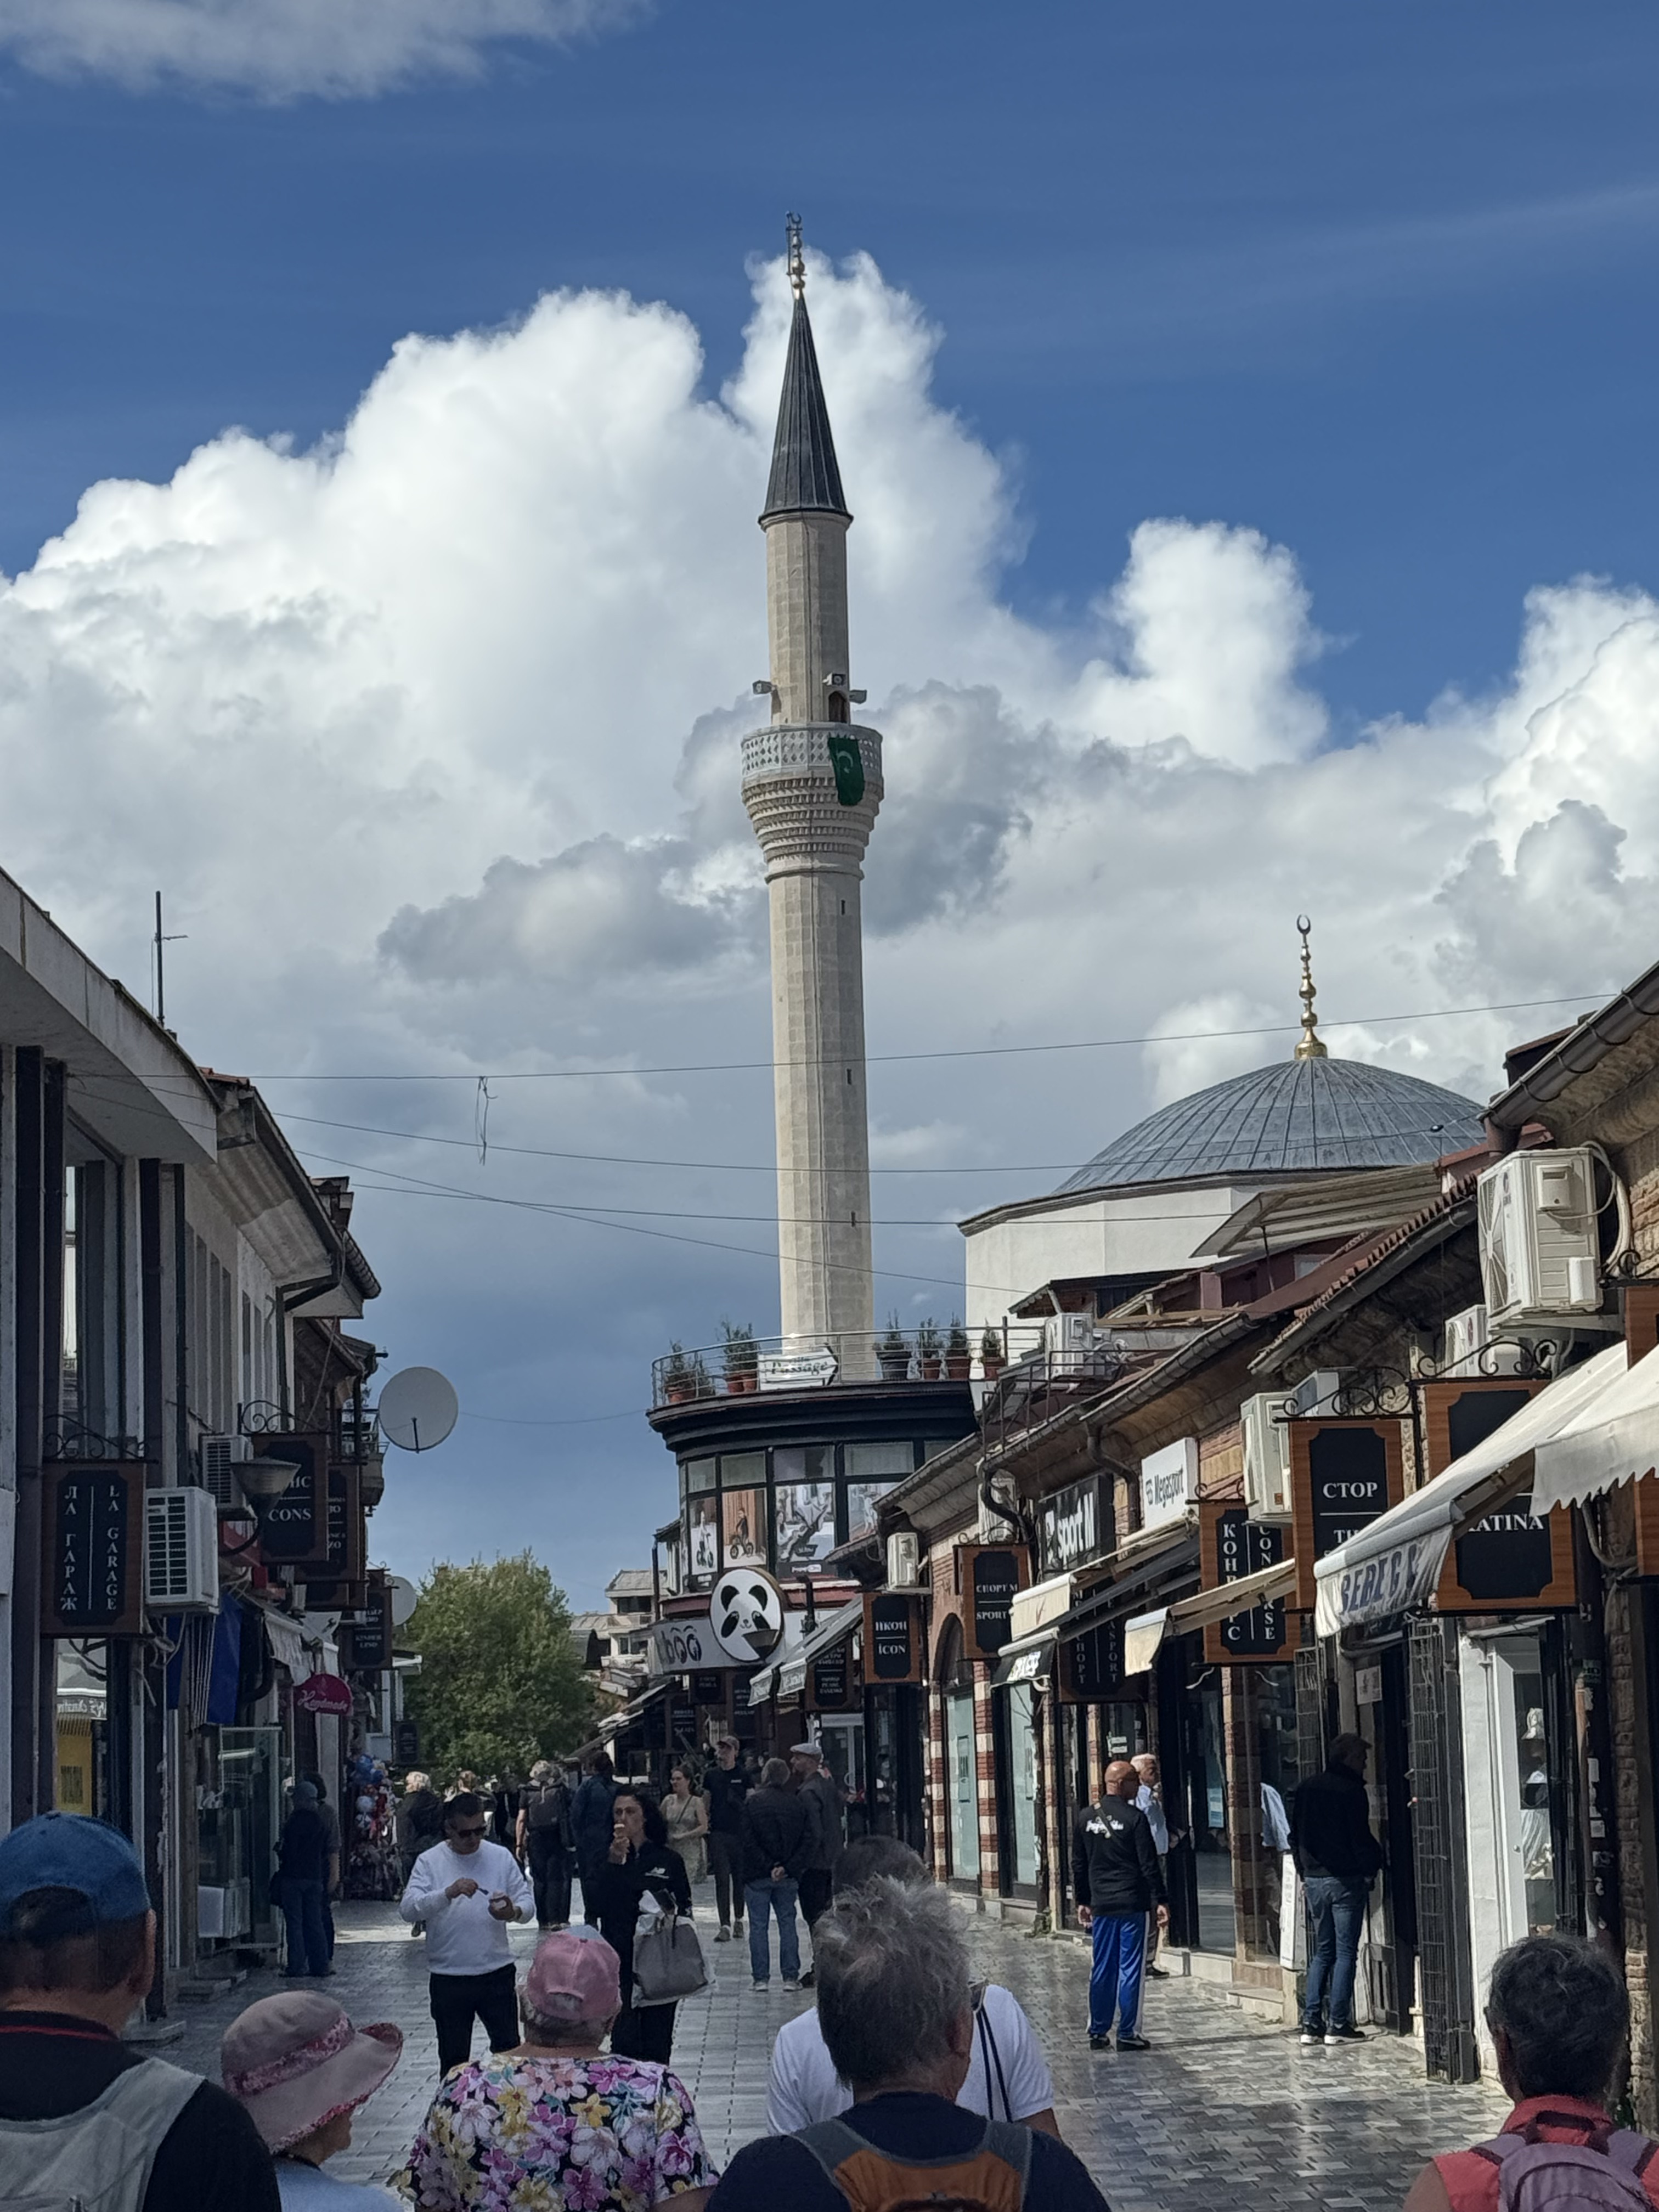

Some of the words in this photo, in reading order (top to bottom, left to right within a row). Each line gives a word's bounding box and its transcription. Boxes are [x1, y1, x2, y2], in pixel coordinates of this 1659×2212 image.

[268, 1508, 312, 1522] CONS
[1468, 1513, 1544, 1532] ATINA
[106, 1527, 120, 1611] GARAGE
[1259, 1525, 1276, 1640] CONRSE
[975, 1611, 1007, 1621] SPORT
[878, 1643, 906, 1655] ICON
